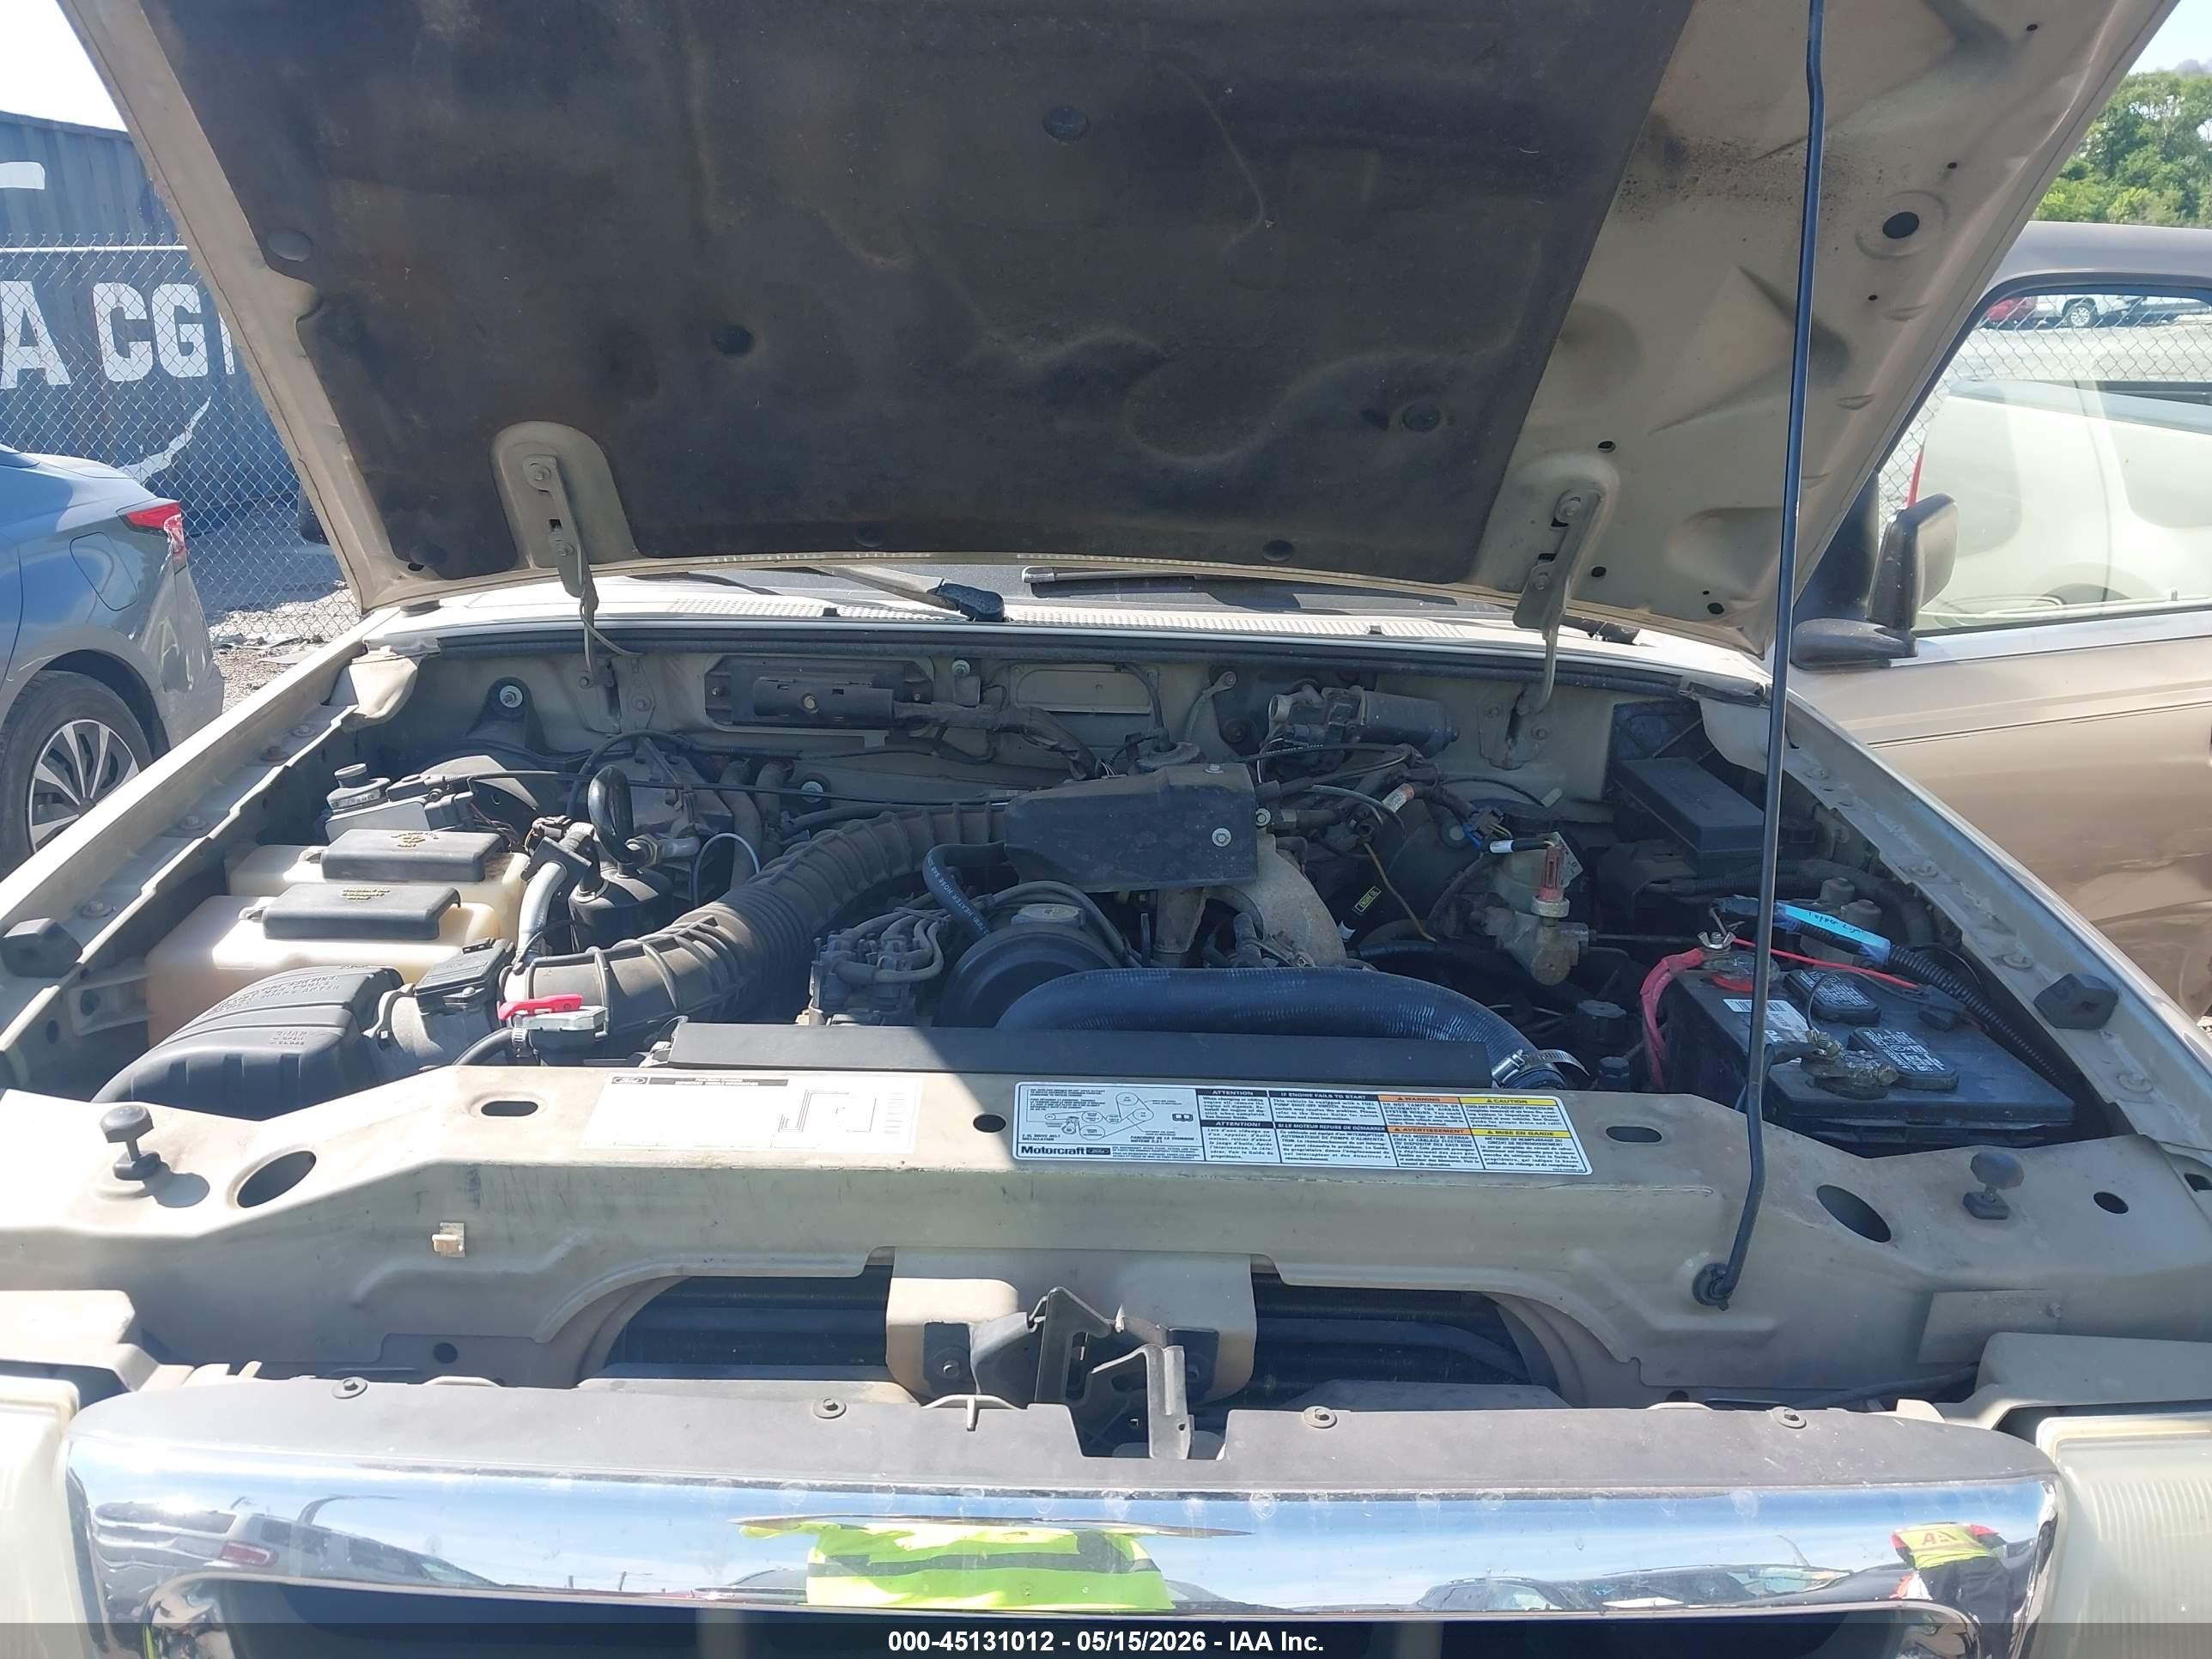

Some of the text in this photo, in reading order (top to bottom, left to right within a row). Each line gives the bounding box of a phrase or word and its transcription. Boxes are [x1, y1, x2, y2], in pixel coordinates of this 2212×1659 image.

[93, 282, 235, 383] CG
[939, 878, 953, 895] HOSE
[952, 893, 974, 916] HEATER
[1021, 1145, 1085, 1154] Motorcraft
